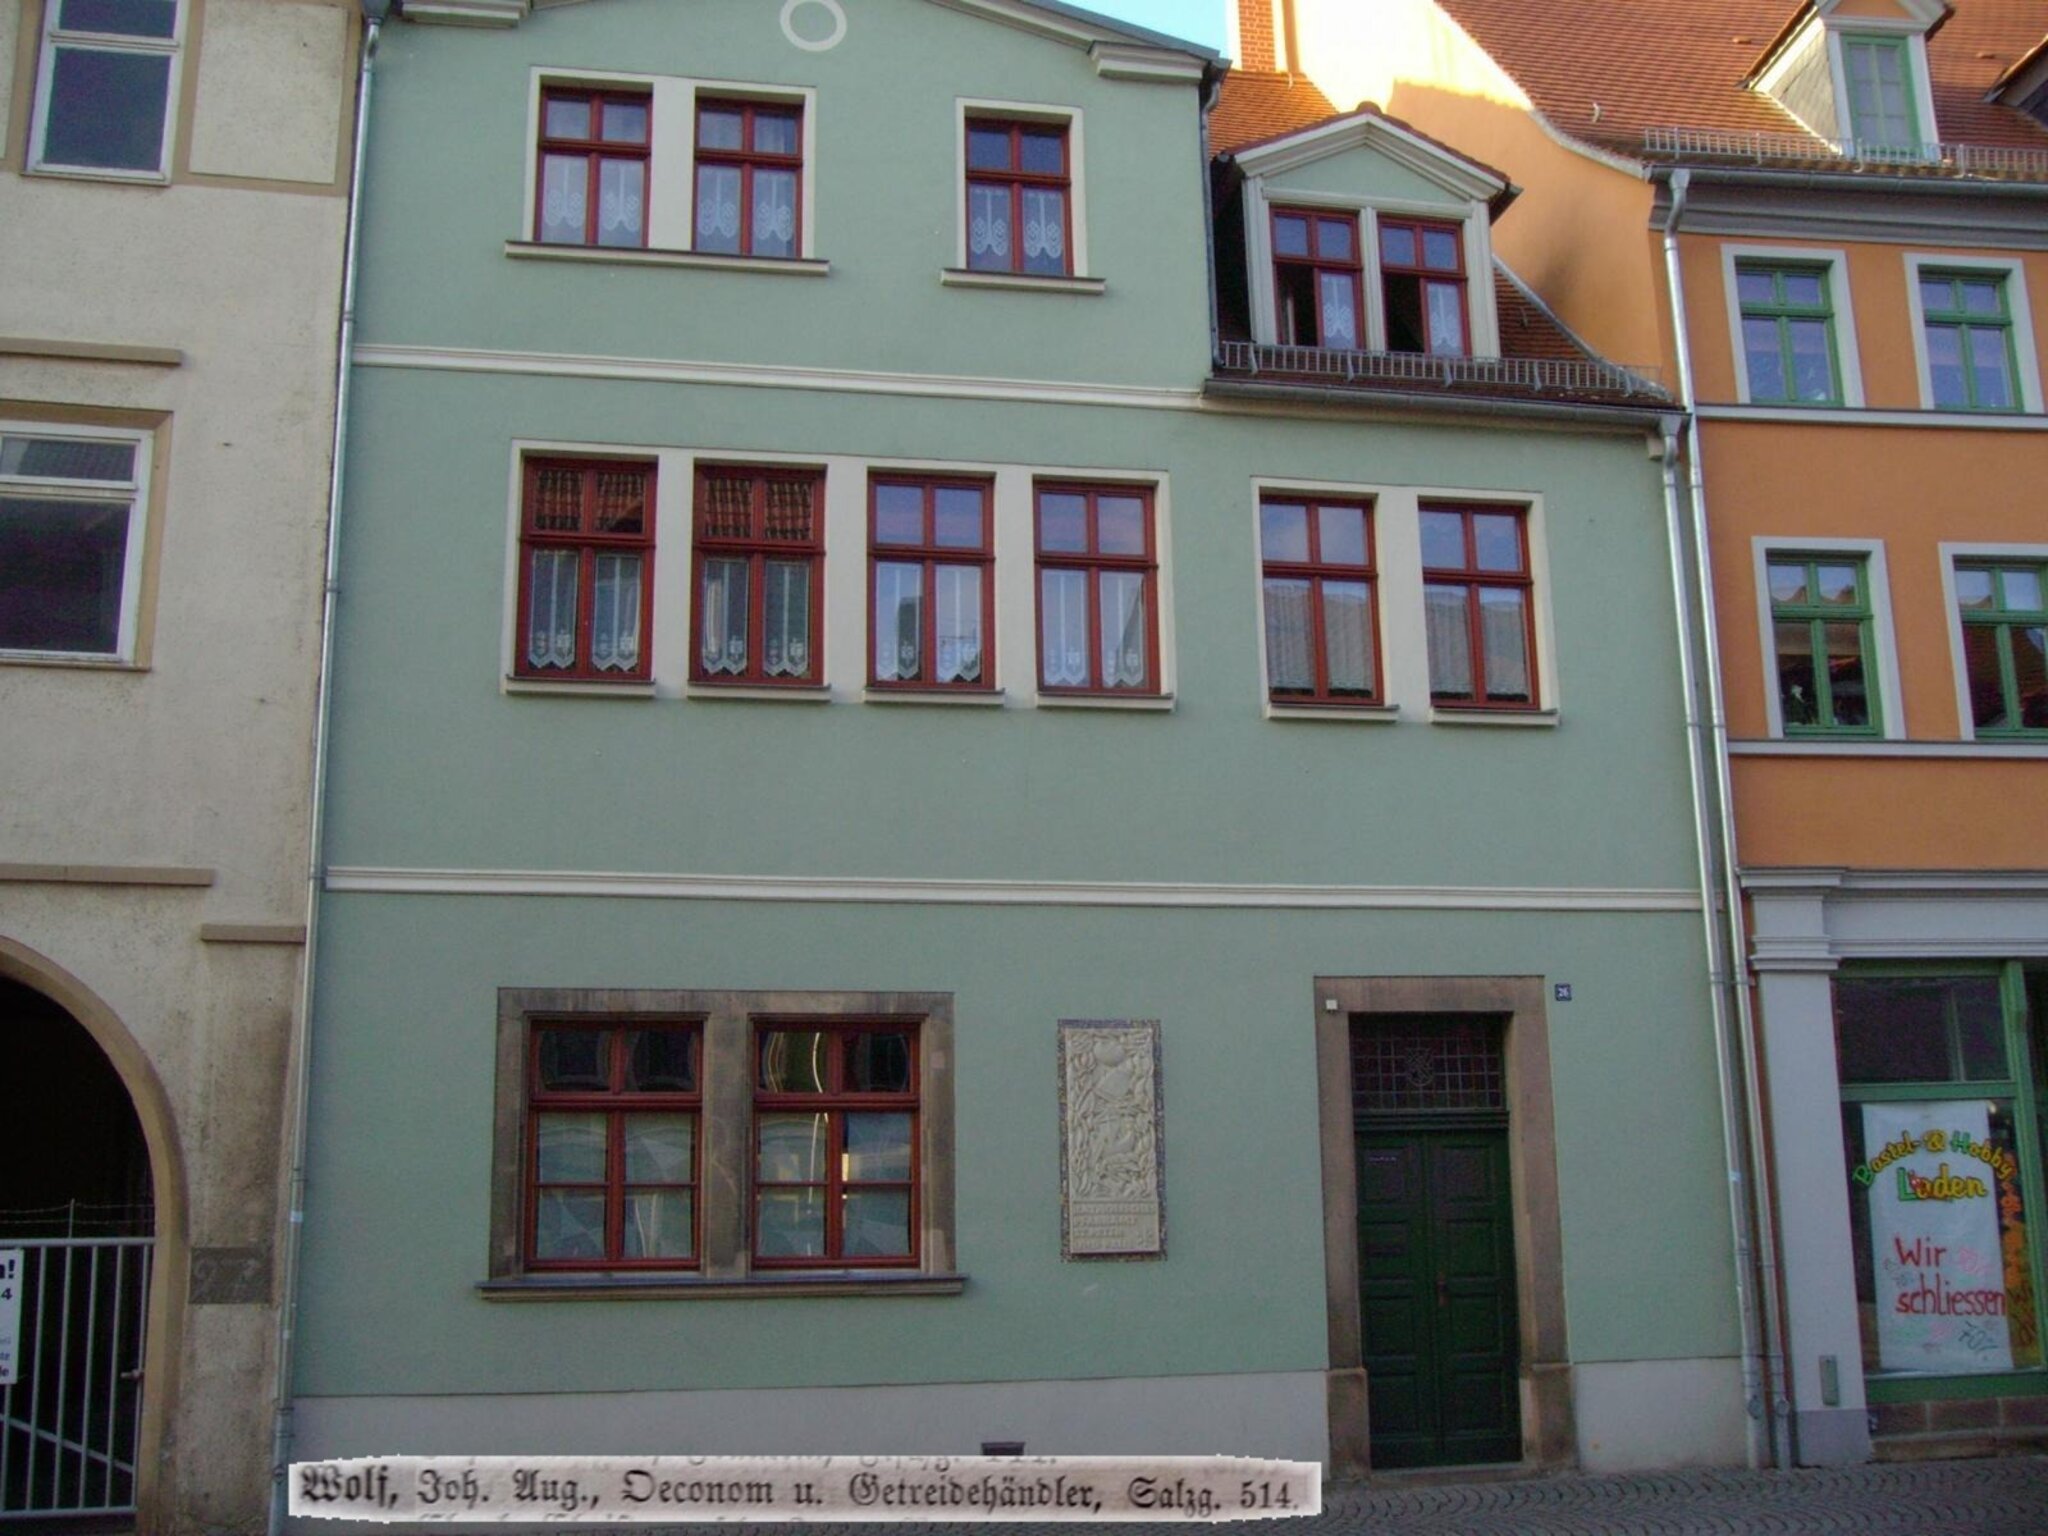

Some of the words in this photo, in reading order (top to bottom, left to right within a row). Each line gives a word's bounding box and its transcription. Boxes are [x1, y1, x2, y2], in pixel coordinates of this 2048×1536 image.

[1896, 1163, 1988, 1202] Laden
[1894, 1236, 1947, 1267] Wir
[1895, 1272, 2005, 1316] schliessen
